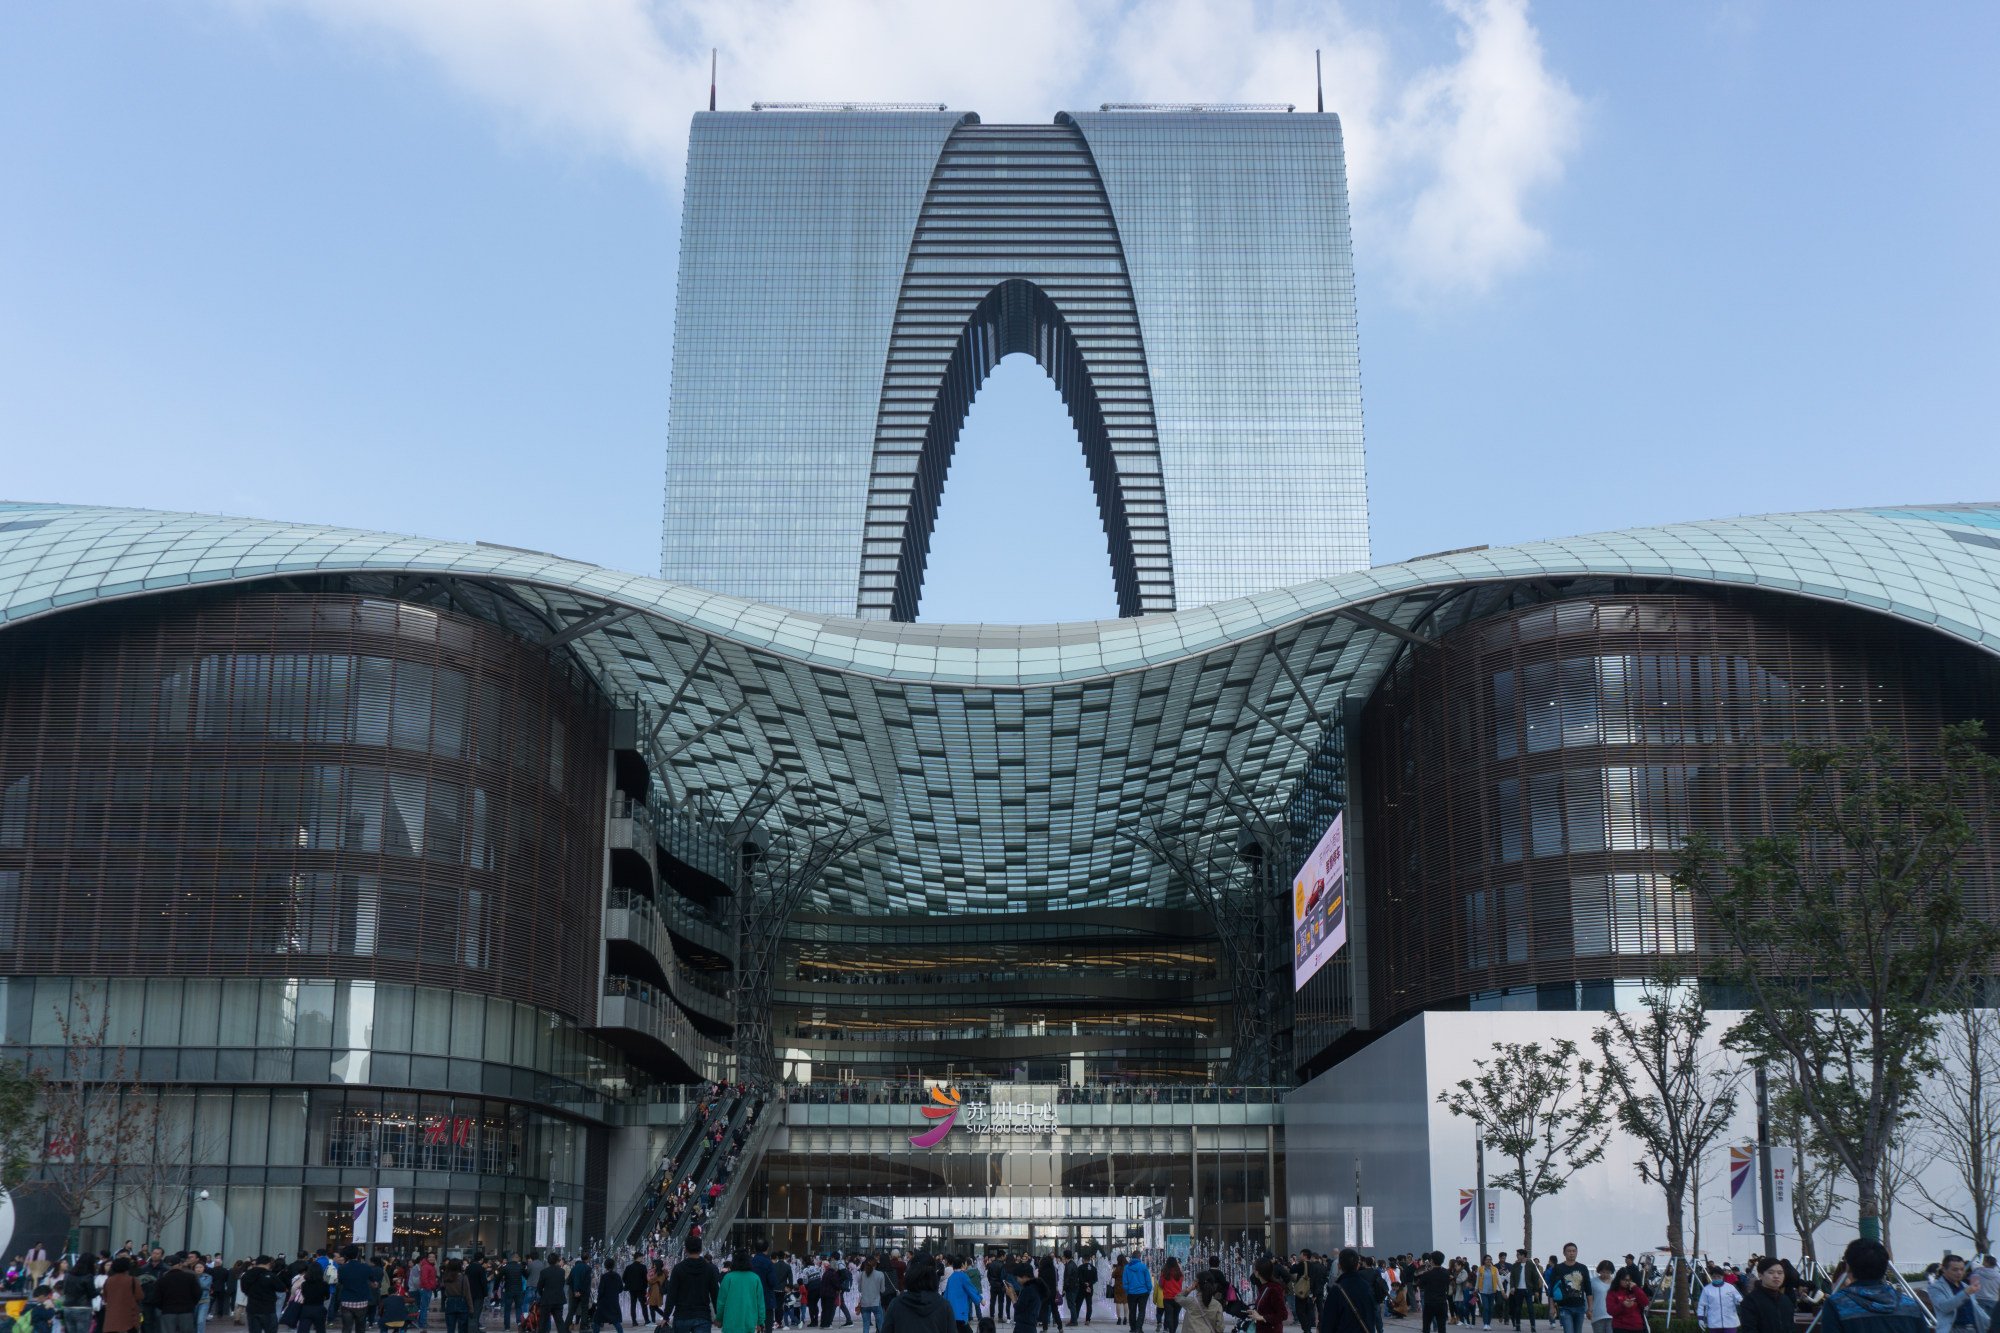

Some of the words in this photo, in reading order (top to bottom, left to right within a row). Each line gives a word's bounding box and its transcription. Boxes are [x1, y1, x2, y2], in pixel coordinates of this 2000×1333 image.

[966, 1101, 1058, 1121] 苏州中心
[423, 1115, 471, 1148] H&M
[966, 1124, 1011, 1134] SUZHOU
[1014, 1124, 1058, 1134] CENTER
